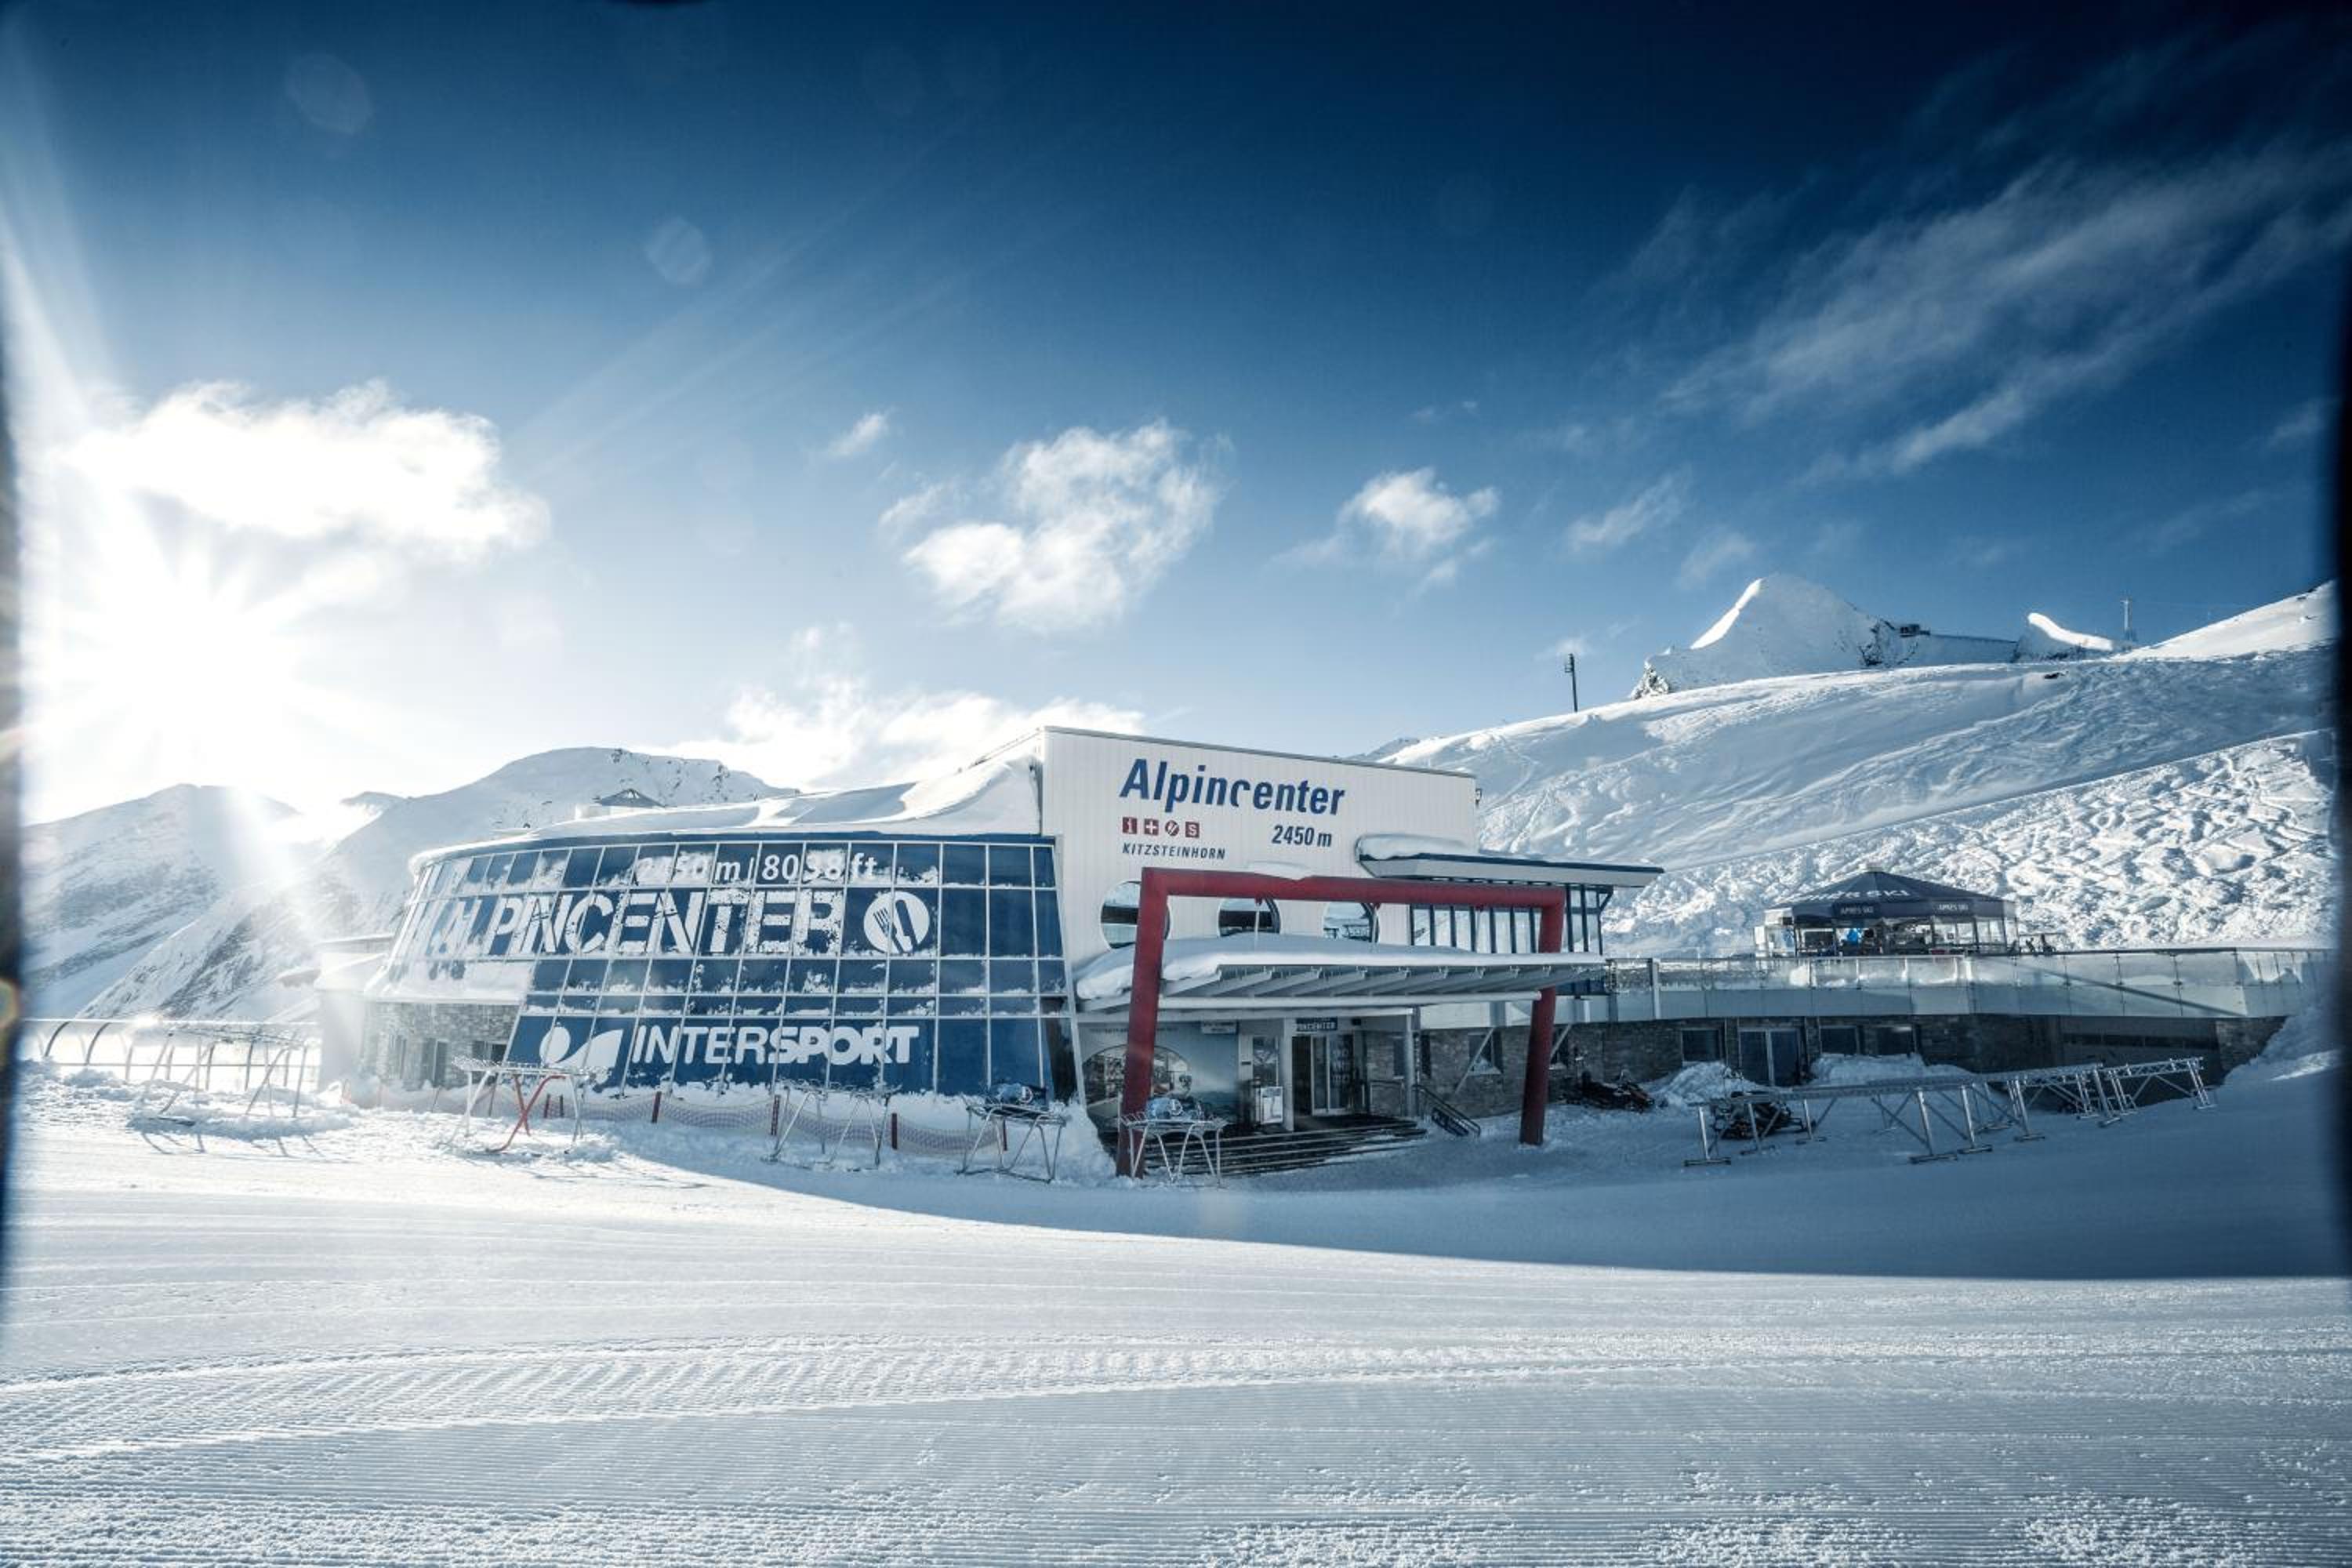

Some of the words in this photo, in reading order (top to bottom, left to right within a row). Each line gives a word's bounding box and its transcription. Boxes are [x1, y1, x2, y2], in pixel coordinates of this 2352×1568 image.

[1120, 758, 1345, 815] Alpincenter
[1122, 842, 1225, 860] KITZSTEINHORN
[1271, 824, 1315, 846] 2450
[1316, 832, 1332, 848] m
[631, 1025, 920, 1065] INTERSPORT
